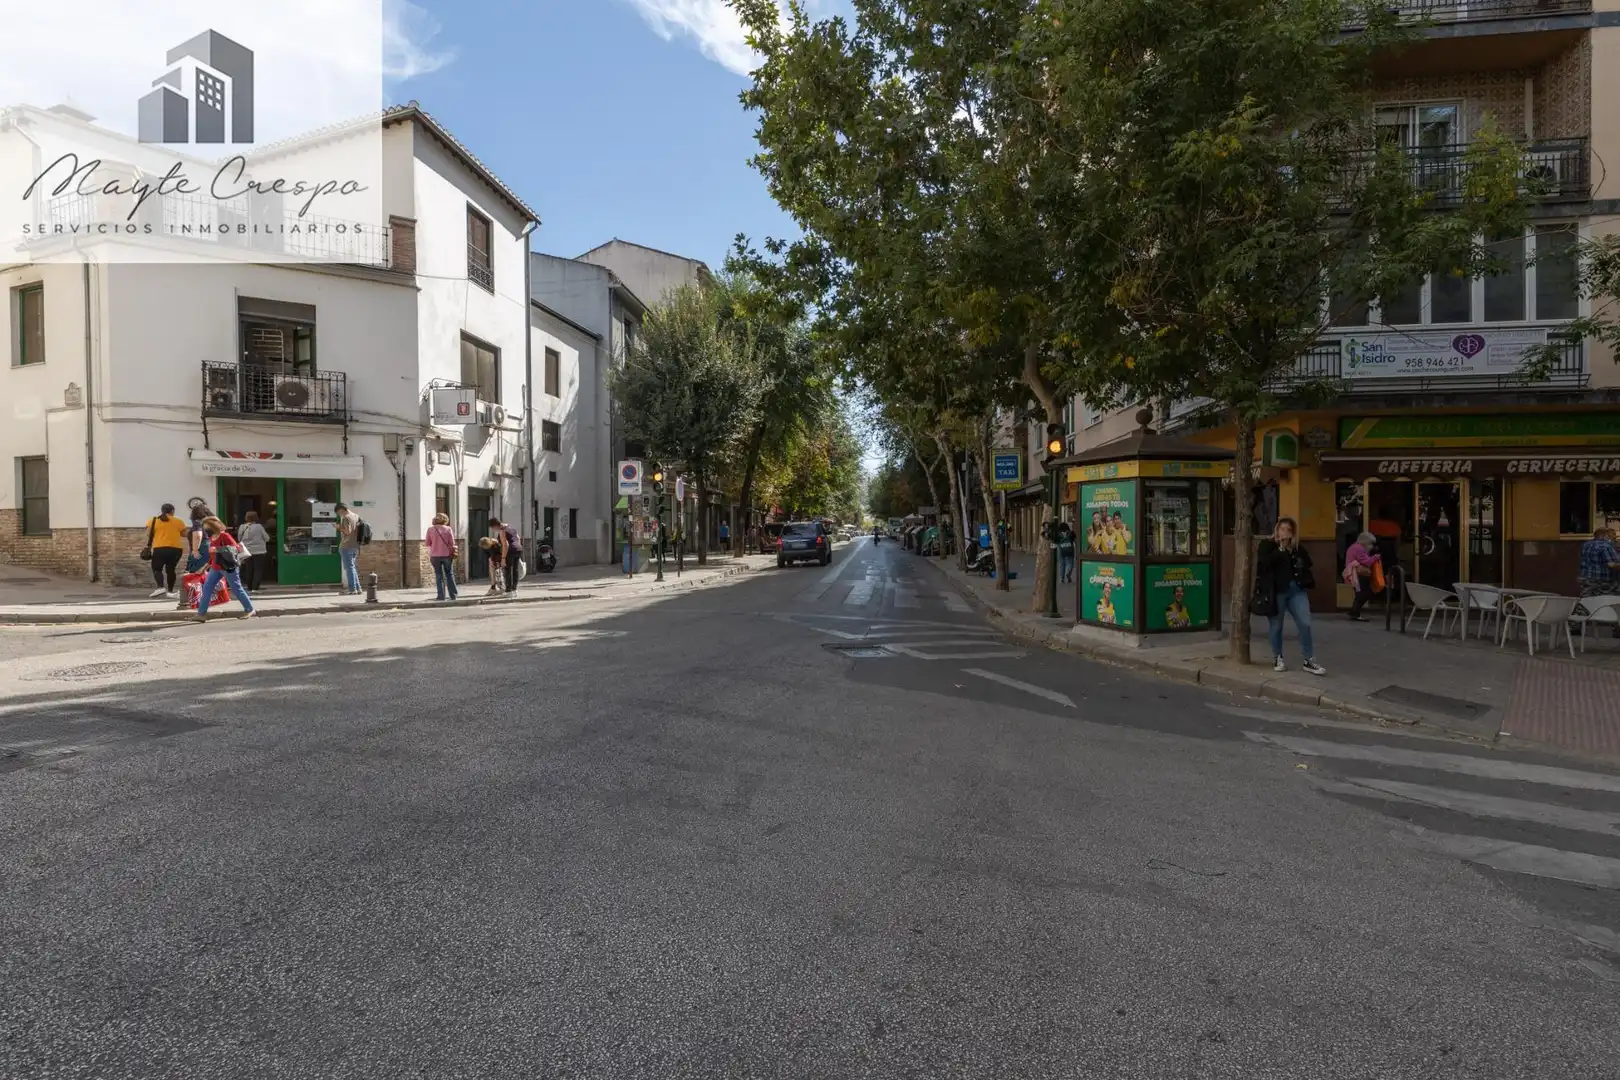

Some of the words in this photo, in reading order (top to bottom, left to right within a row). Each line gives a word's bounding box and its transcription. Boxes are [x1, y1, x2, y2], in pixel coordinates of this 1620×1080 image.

[1361, 341, 1382, 352] San
[1362, 352, 1396, 364] Isidro
[1405, 358, 1423, 367] 958
[1426, 357, 1444, 367] 946
[1447, 356, 1464, 366] 421
[242, 465, 257, 473] Dios
[1379, 460, 1473, 474] CAFETERIA
[1506, 458, 1620, 473] CERVECERIA
[1111, 500, 1129, 508] TODOS
